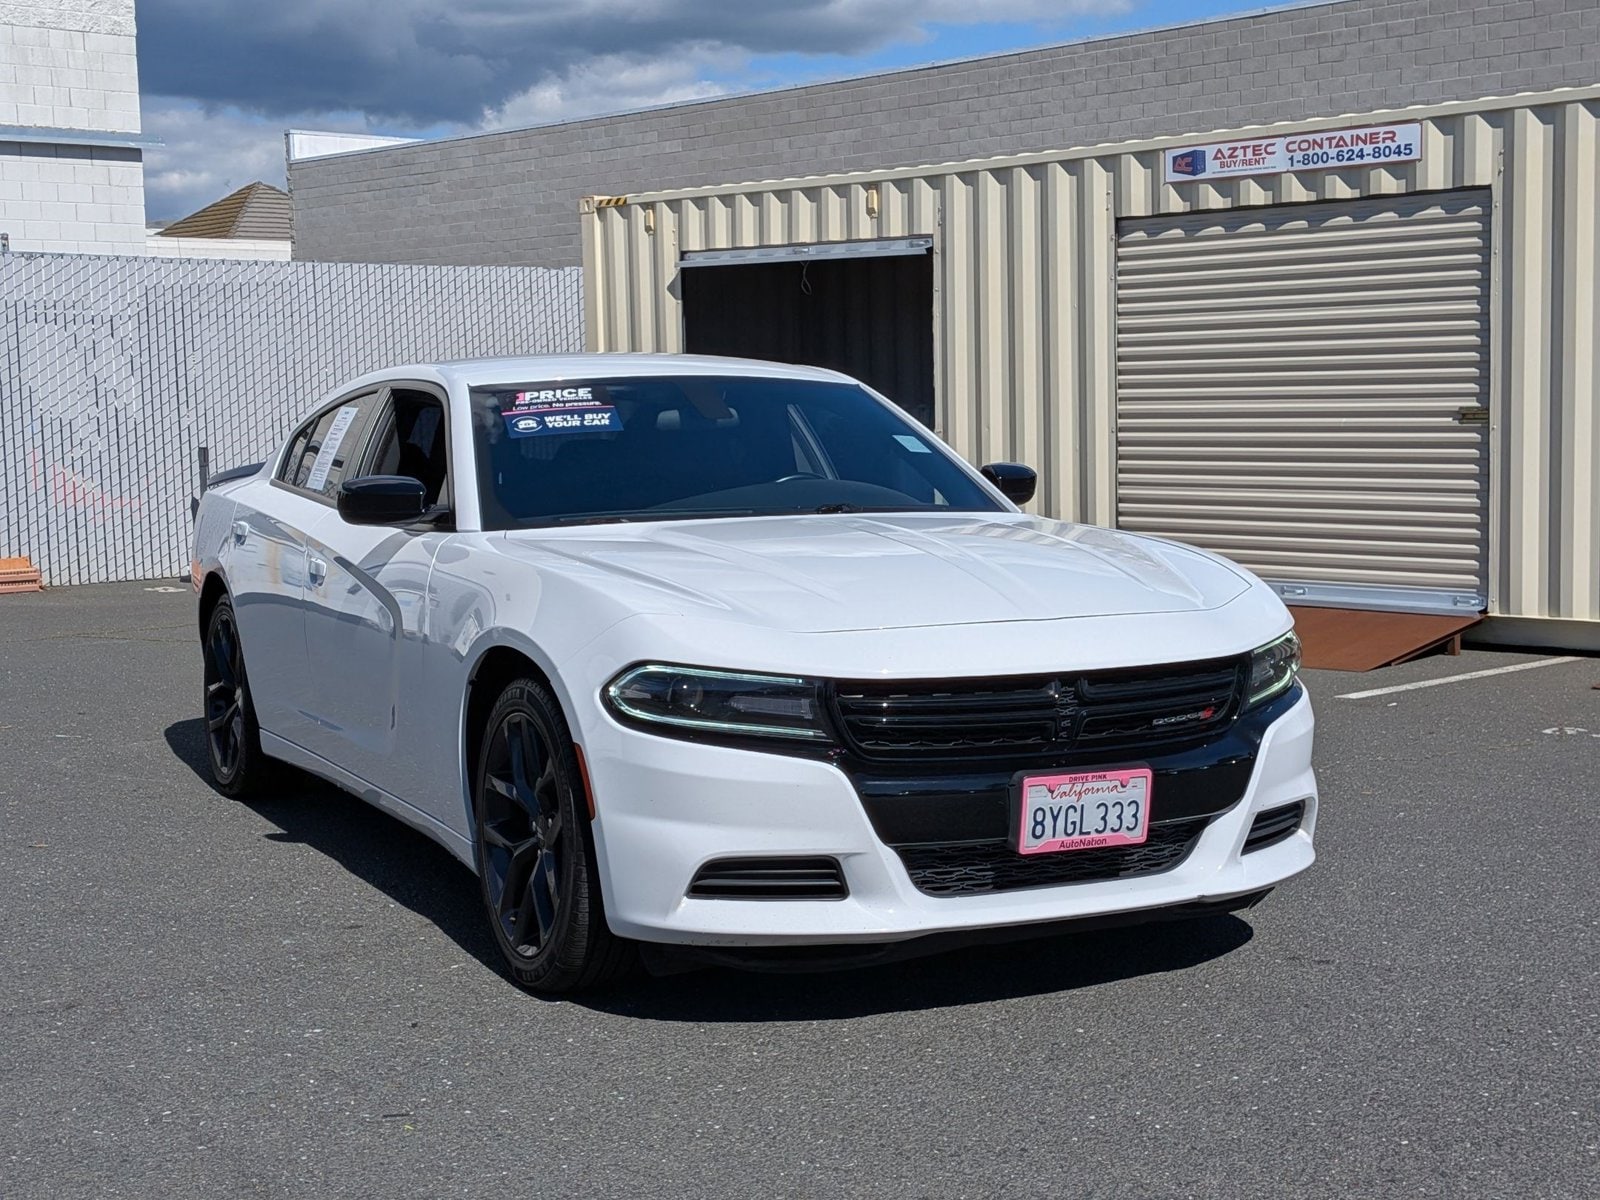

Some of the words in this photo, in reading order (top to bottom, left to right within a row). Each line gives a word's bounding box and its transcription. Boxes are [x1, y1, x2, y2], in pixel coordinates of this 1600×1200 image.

[1212, 142, 1277, 161] AZTEC
[1285, 130, 1397, 153] CONTAINER
[1219, 157, 1267, 169] BUY/RENT
[1287, 143, 1413, 168] 1-800-624-8045
[544, 414, 581, 422] WE'LL
[1068, 775, 1090, 783] DRIVE
[1051, 782, 1126, 802] California
[1031, 800, 1140, 840] 8YGL333
[1058, 838, 1107, 850] AutoNation
